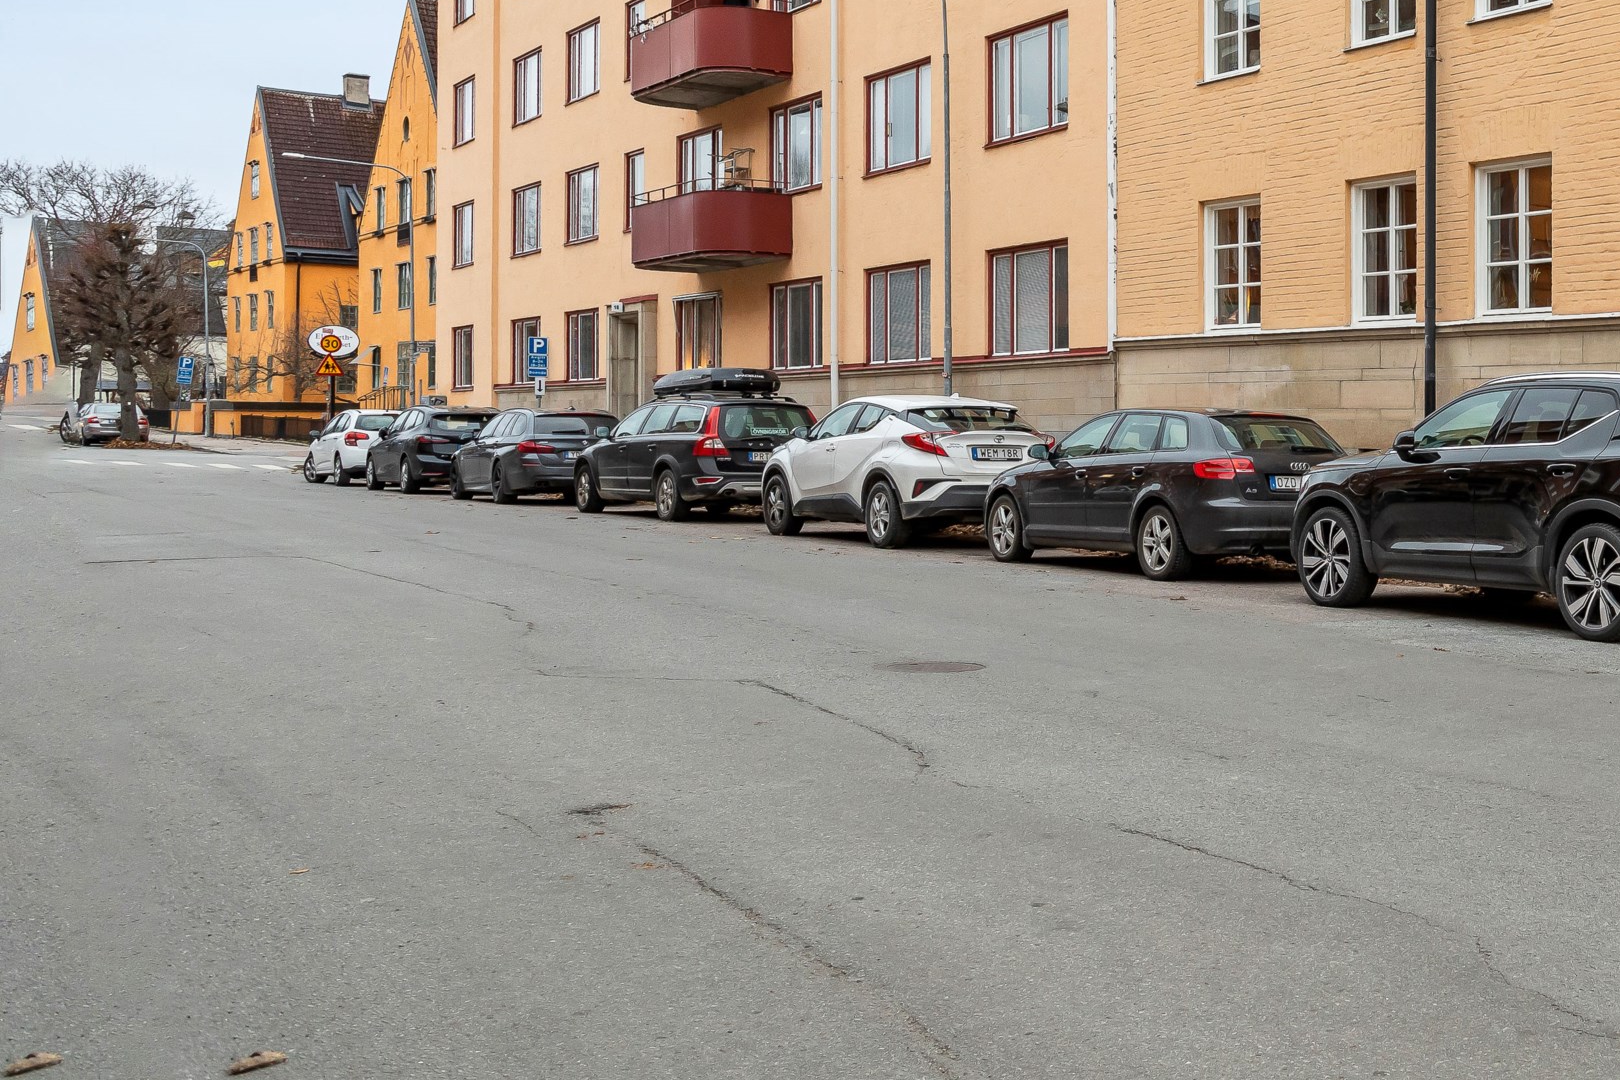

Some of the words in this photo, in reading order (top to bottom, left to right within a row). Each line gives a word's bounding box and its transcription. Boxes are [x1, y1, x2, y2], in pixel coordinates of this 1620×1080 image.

[324, 339, 339, 349] 30
[533, 339, 545, 353] P
[182, 358, 192, 368] P
[980, 448, 999, 458] WEM
[1001, 448, 1019, 458] 18R
[1277, 477, 1297, 488] OZD
